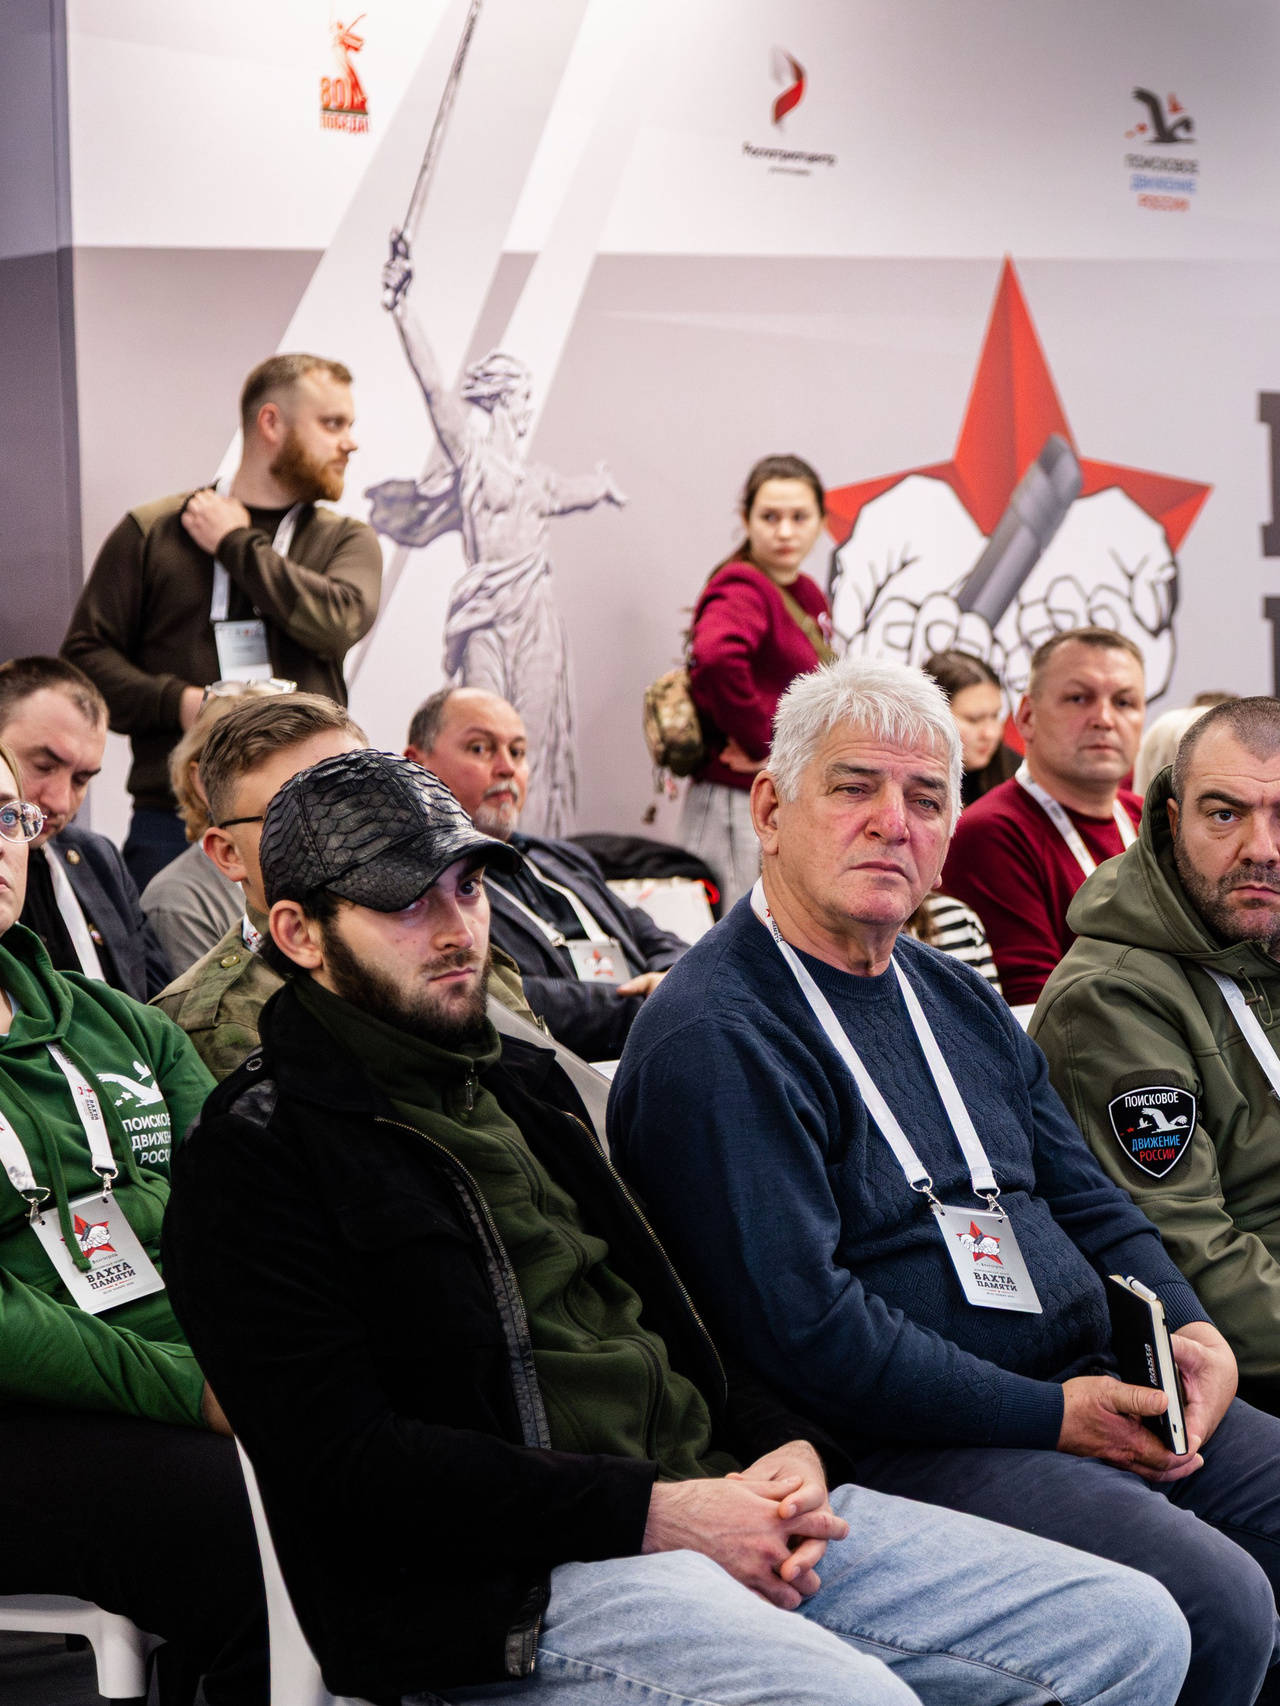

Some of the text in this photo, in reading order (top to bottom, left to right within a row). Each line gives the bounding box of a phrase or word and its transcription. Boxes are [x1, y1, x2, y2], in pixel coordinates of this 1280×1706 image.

[1124, 1092, 1179, 1108] ПОИСКОВОЕ
[1132, 1134, 1181, 1152] ДВИЖЕНИЕ
[1139, 1148, 1176, 1162] РОССИИ
[85, 1262, 132, 1283] ВАХТА
[90, 1269, 136, 1290] ПАМЯТИ
[973, 1271, 1015, 1285] ВАХТА
[976, 1280, 1018, 1292] ПАМЯТИ
